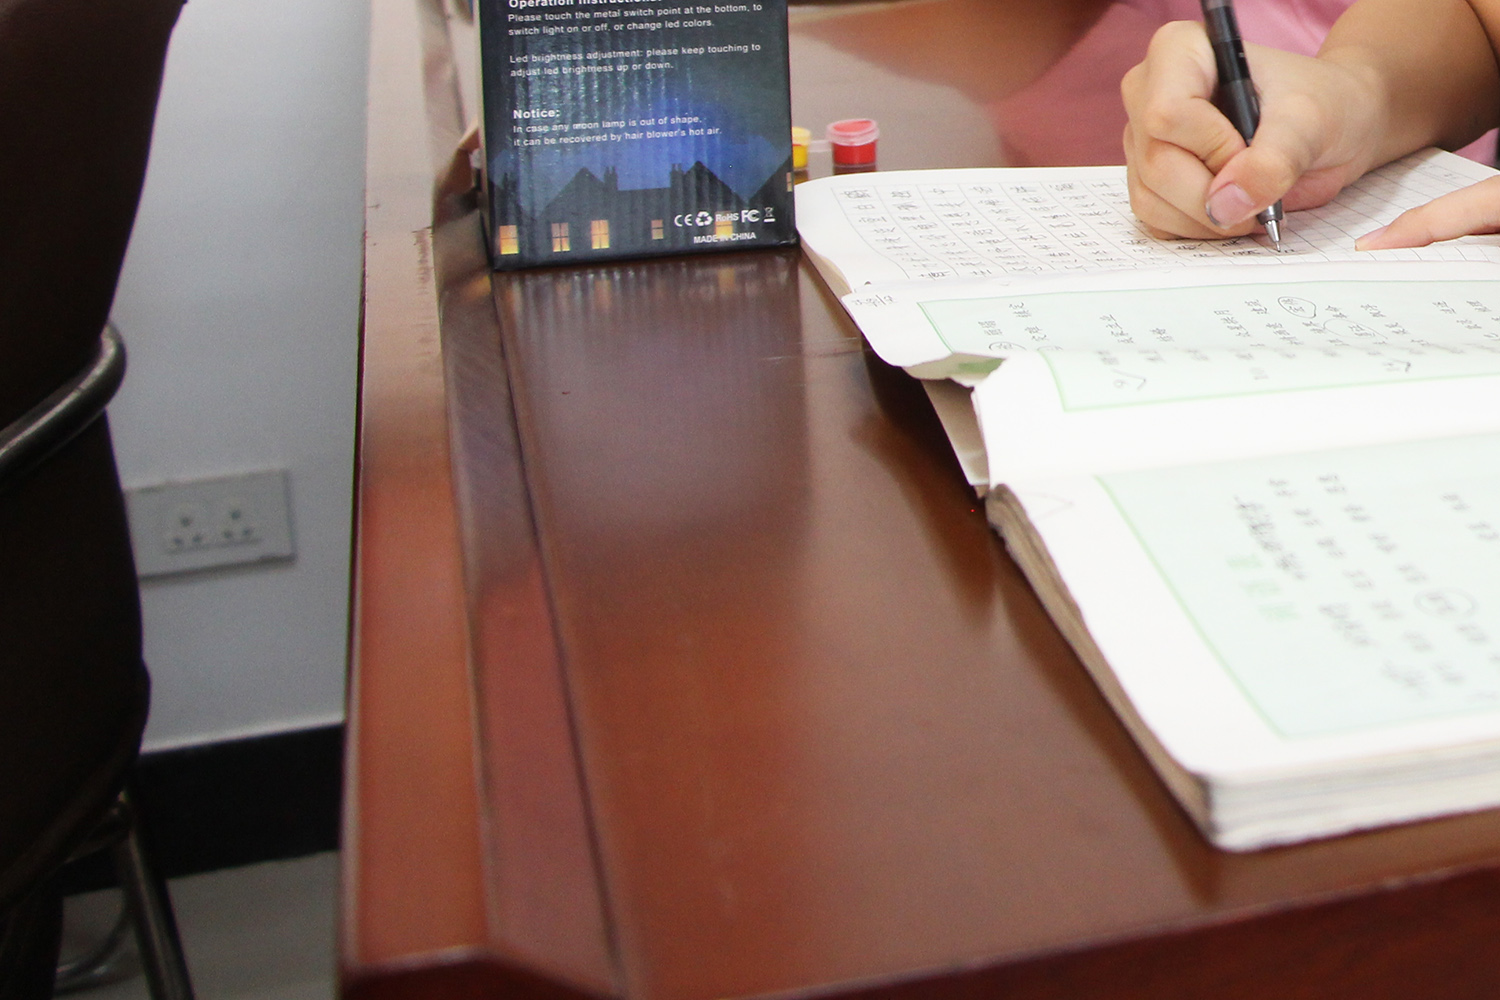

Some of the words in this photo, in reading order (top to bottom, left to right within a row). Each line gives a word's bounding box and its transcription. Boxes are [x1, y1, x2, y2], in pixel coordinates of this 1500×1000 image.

[508, 13, 542, 22] Please
[545, 12, 572, 21] touch
[575, 11, 591, 19] the
[593, 9, 621, 18] metal
[623, 8, 654, 17] switch
[657, 6, 681, 17] point
[696, 5, 711, 13] the
[752, 3, 763, 11] to
[508, 26, 540, 36] switch
[542, 25, 564, 36] light
[566, 25, 579, 33] on
[581, 24, 592, 32] or
[613, 23, 625, 31] or
[626, 20, 662, 31] change
[664, 20, 680, 28] led
[682, 19, 715, 28] colors.
[509, 55, 528, 63] Led
[531, 52, 583, 63] brightness
[586, 49, 644, 60] adjustment:
[646, 47, 679, 57] please
[681, 47, 705, 55] keep
[707, 44, 749, 53] touching
[751, 43, 761, 51] to
[510, 68, 541, 78] adjust
[543, 67, 560, 75] led
[562, 64, 614, 75] brightness
[616, 63, 629, 72] up
[631, 63, 642, 71] or
[644, 61, 674, 70] down.
[512, 108, 560, 119] Notice:
[513, 125, 523, 133] In
[525, 124, 550, 133] case
[551, 123, 569, 132] any
[602, 119, 626, 129] lamp
[628, 119, 637, 127] is
[639, 118, 656, 126] out
[657, 117, 669, 125] of
[523, 138, 541, 146] can
[543, 136, 557, 145] be
[559, 133, 608, 144] recovered
[610, 133, 622, 142] by
[624, 131, 644, 140] hair
[646, 128, 687, 139] blower's
[688, 127, 705, 136] hot
[707, 126, 722, 135] air.
[715, 212, 740, 222] RoHS
[693, 235, 718, 244] MADE
[730, 232, 757, 241] CHINA
